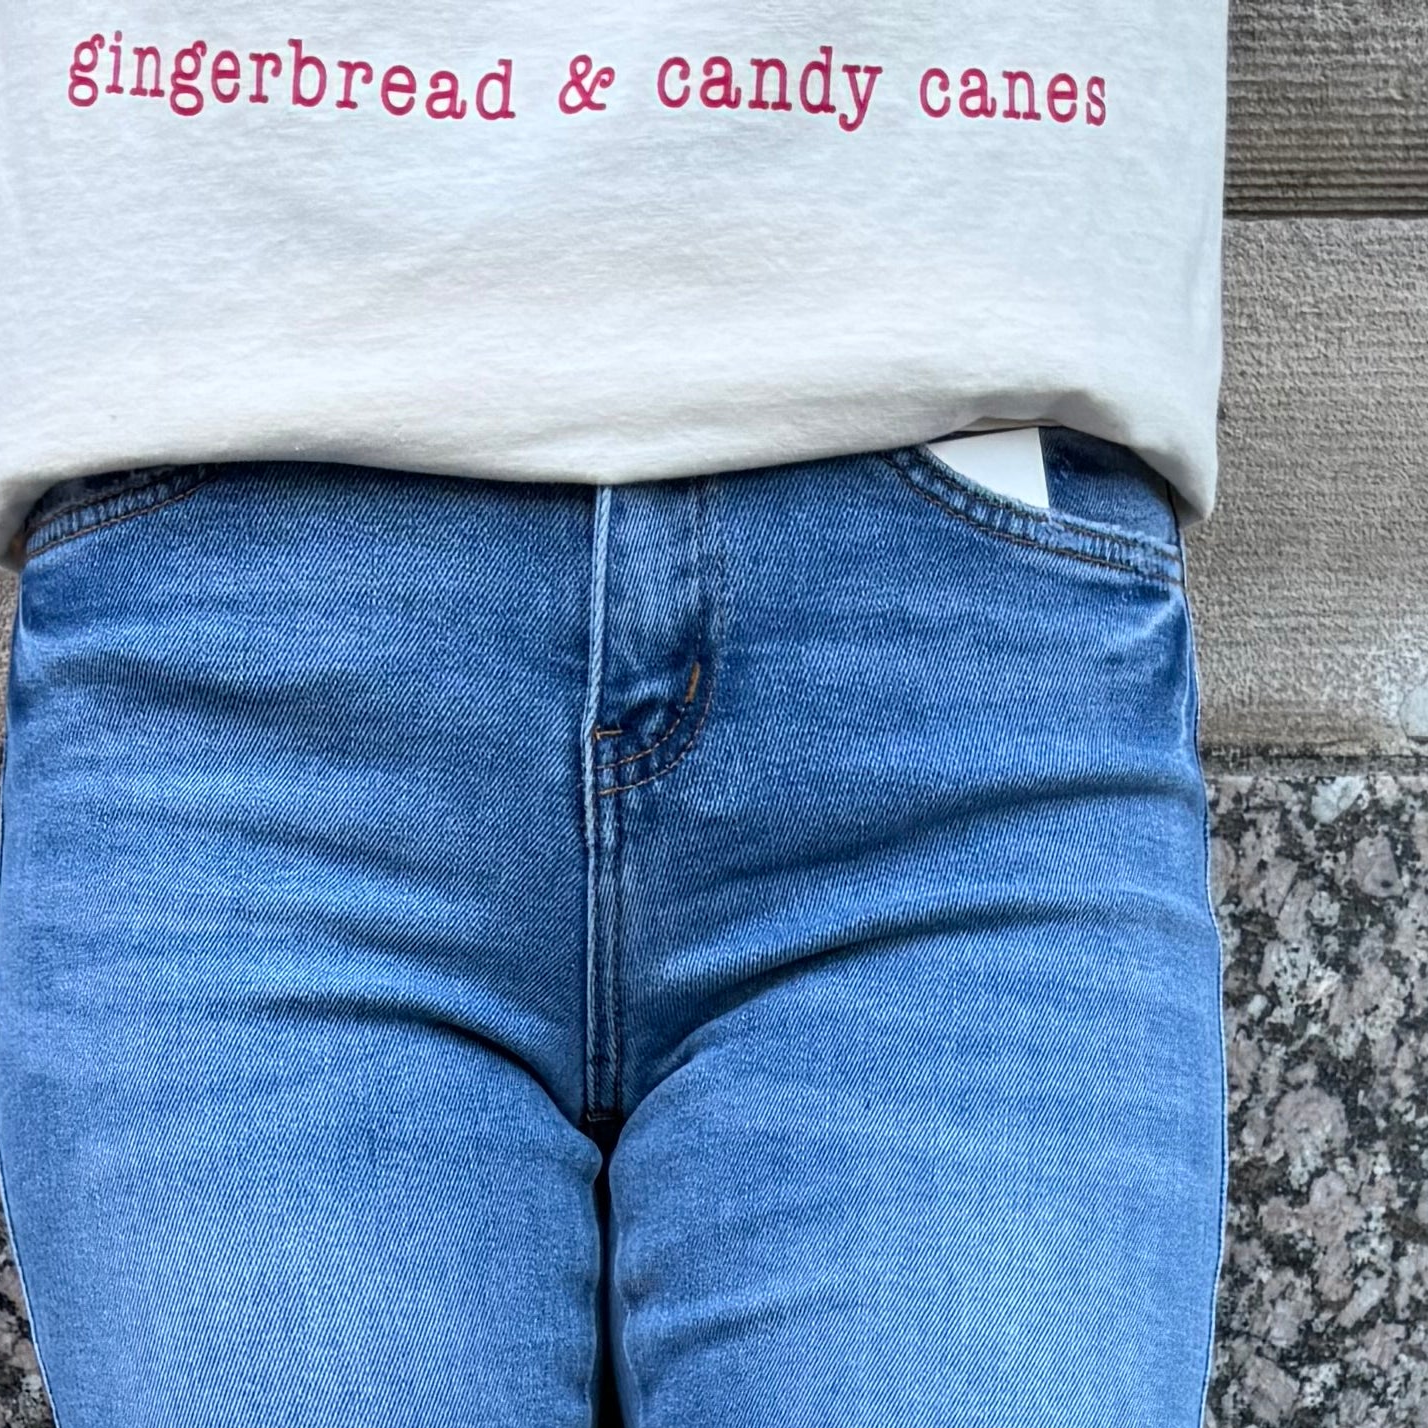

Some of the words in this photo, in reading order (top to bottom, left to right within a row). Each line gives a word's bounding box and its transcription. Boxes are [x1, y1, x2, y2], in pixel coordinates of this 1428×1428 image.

[68, 30, 516, 121] gingerbread
[559, 54, 616, 115] &
[657, 46, 883, 132] candy
[919, 67, 1107, 127] canes
